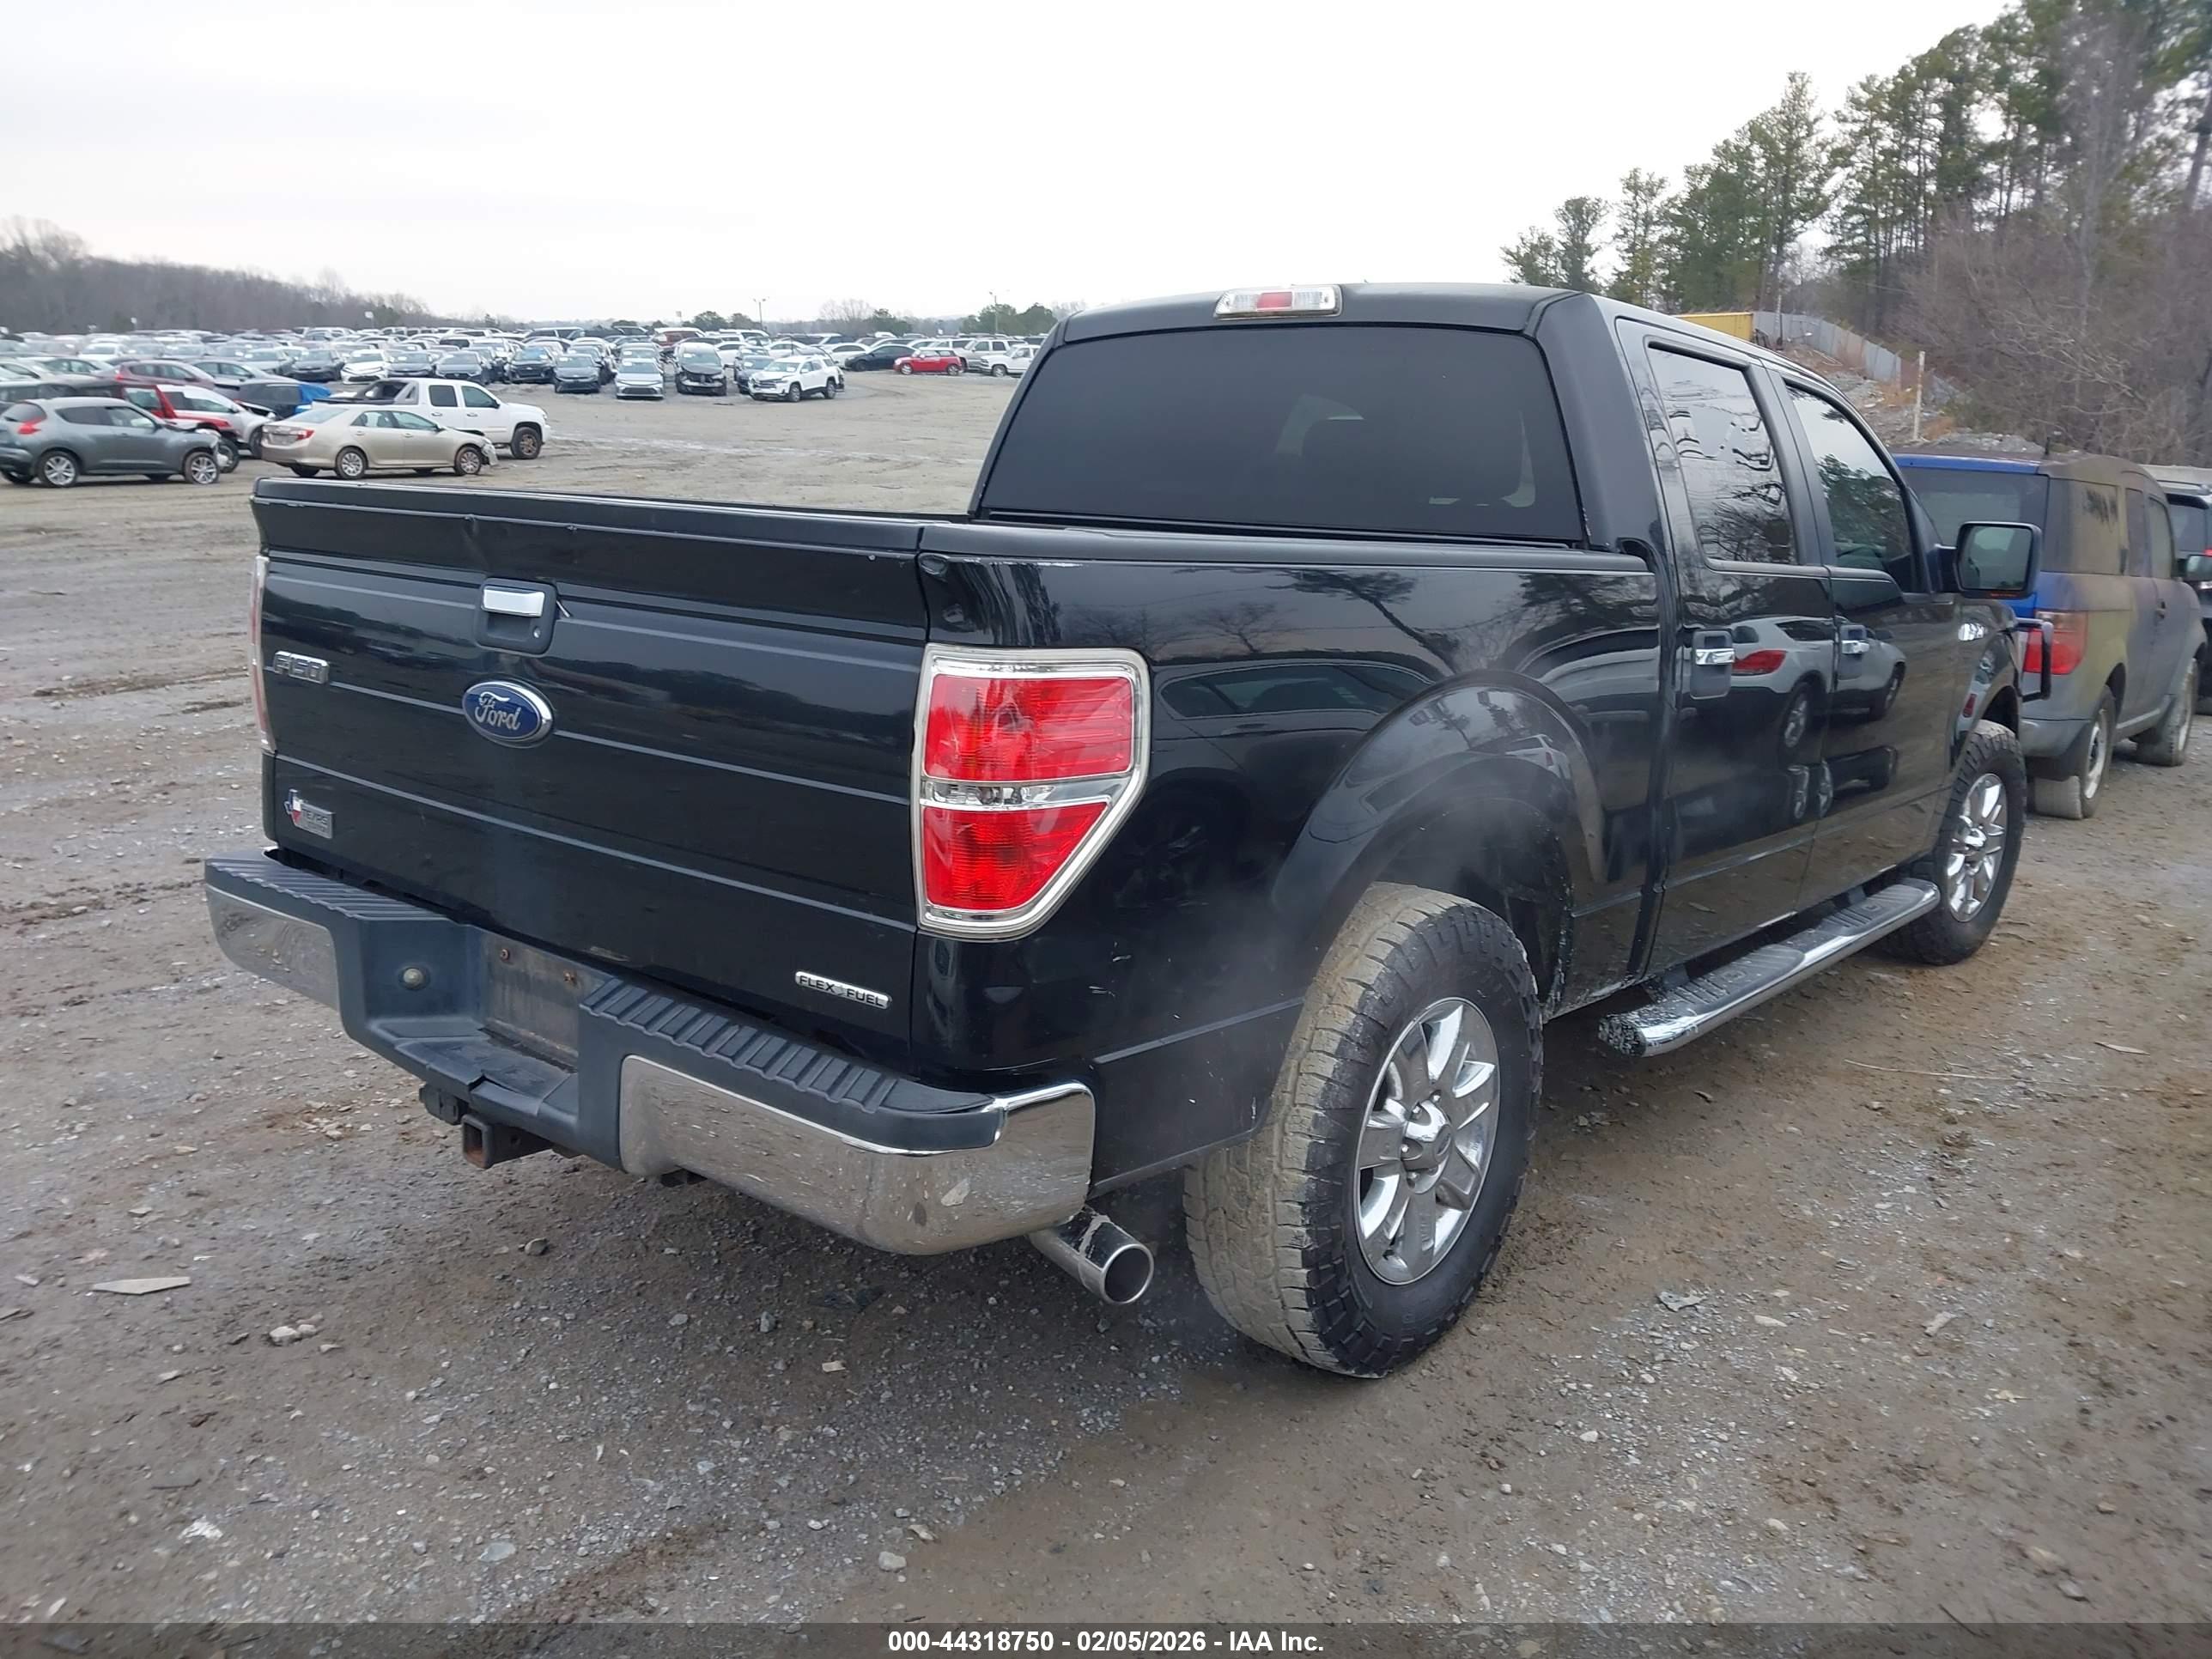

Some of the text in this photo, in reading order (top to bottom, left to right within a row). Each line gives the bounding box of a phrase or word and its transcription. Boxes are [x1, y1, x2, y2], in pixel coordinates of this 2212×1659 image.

[475, 691, 522, 730] Ford
[799, 975, 884, 1007] FLEX FUEL
